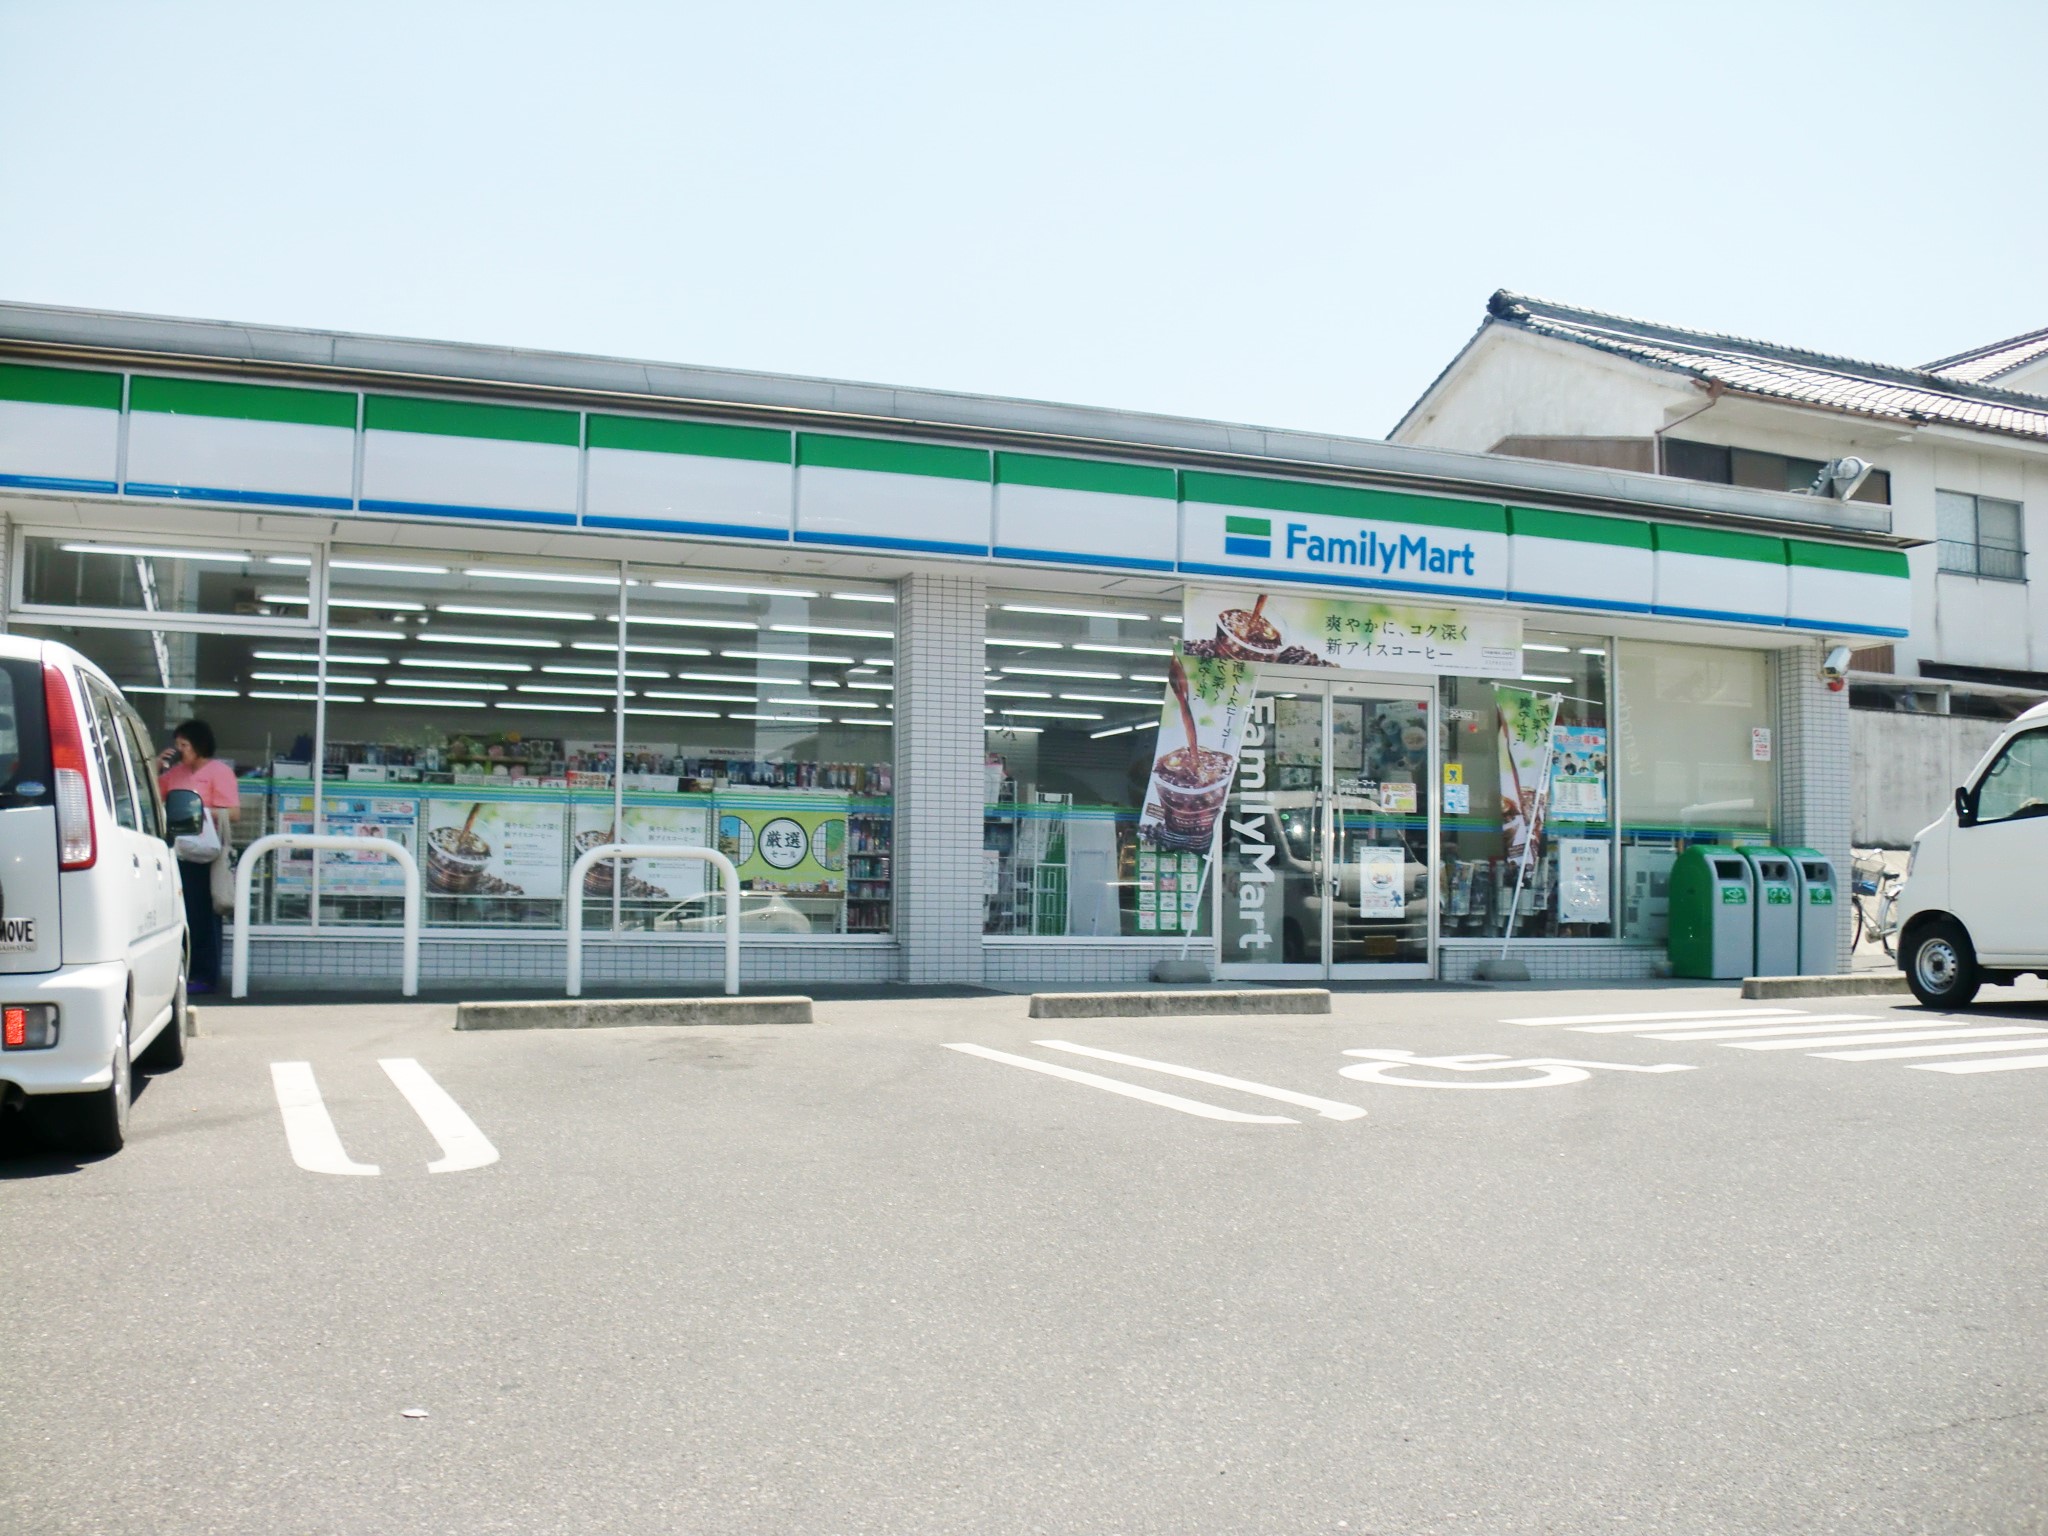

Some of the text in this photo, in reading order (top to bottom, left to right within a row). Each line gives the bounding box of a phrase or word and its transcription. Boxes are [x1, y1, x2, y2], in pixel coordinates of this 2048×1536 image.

[1286, 522, 1475, 576] FamilyMart
[1326, 614, 1469, 641] 爽やかに、コク深く
[1326, 638, 1454, 660] 新アイスコーヒー
[1230, 697, 1276, 949] FamilyMart
[766, 830, 802, 848] 厳選
[770, 850, 796, 859] セール
